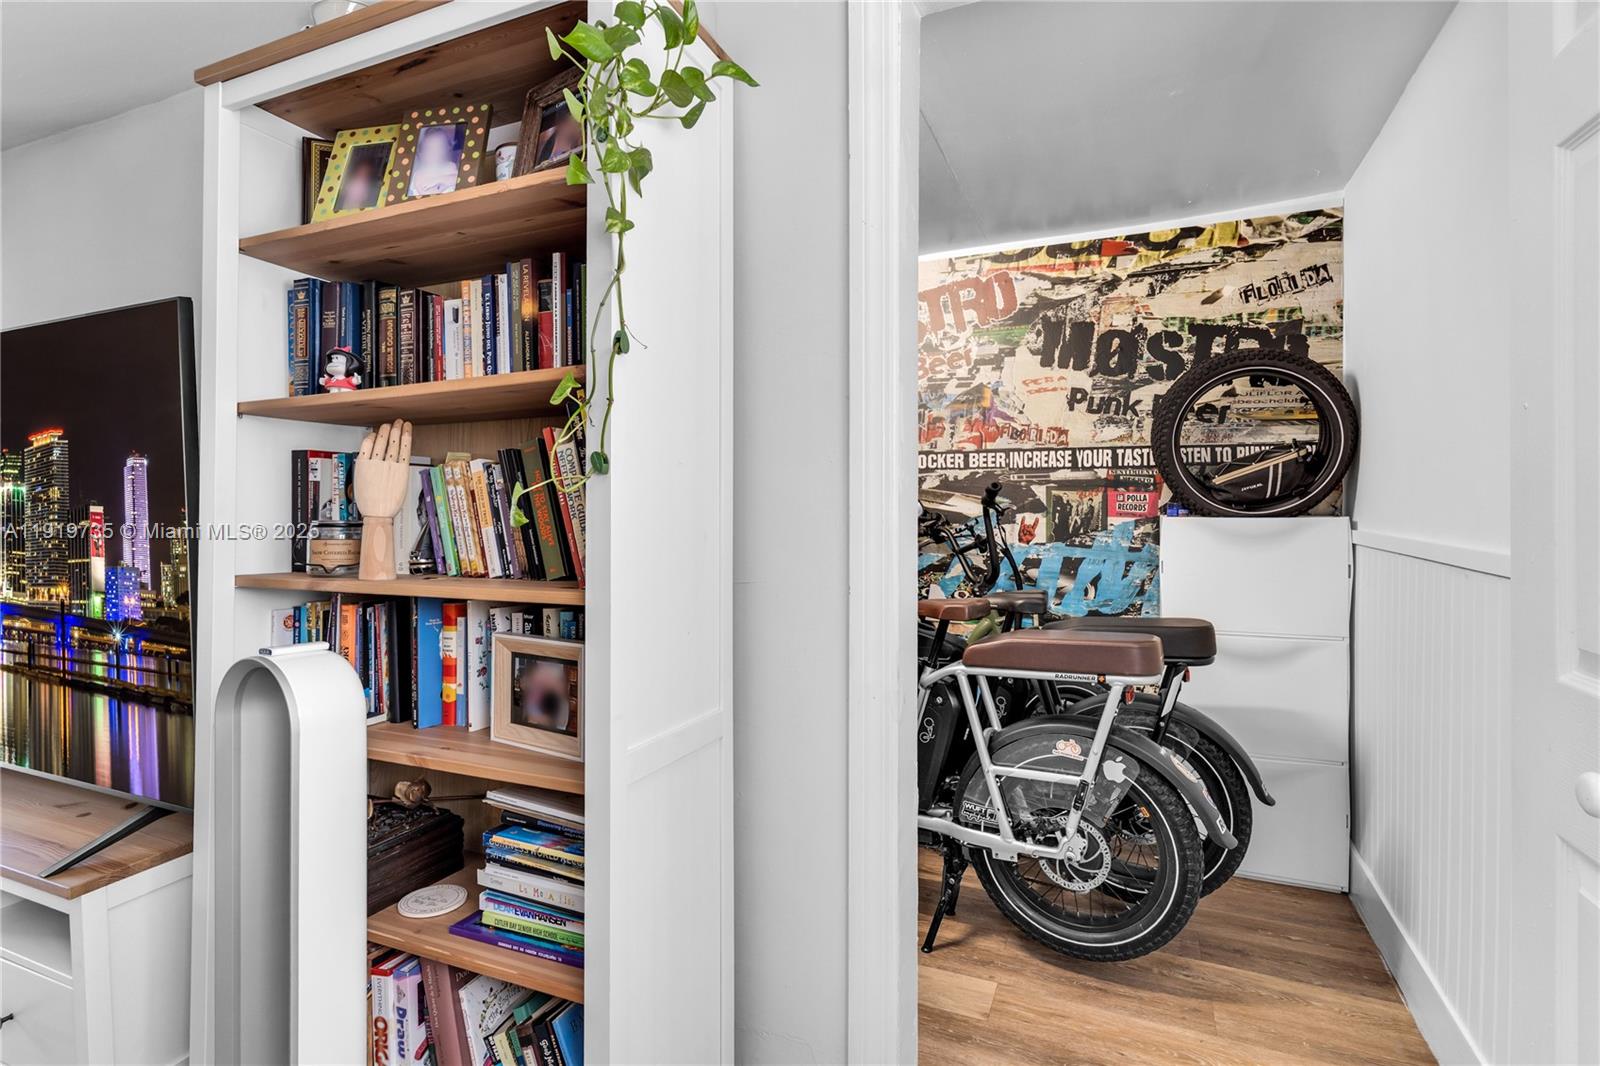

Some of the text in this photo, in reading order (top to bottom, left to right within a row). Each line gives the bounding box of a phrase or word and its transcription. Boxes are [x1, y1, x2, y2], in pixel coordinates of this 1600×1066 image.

[1240, 263, 1333, 305] FLORIDA
[1067, 387, 1141, 418] Punk
[1076, 449, 1112, 468] YOUR
[1214, 446, 1232, 463] TO
[1118, 503, 1147, 512] RECORDS
[1126, 494, 1148, 502] POLLA
[514, 909, 534, 920] EVAN
[534, 913, 566, 927] HANSEN
[396, 1006, 407, 1059] Draw
